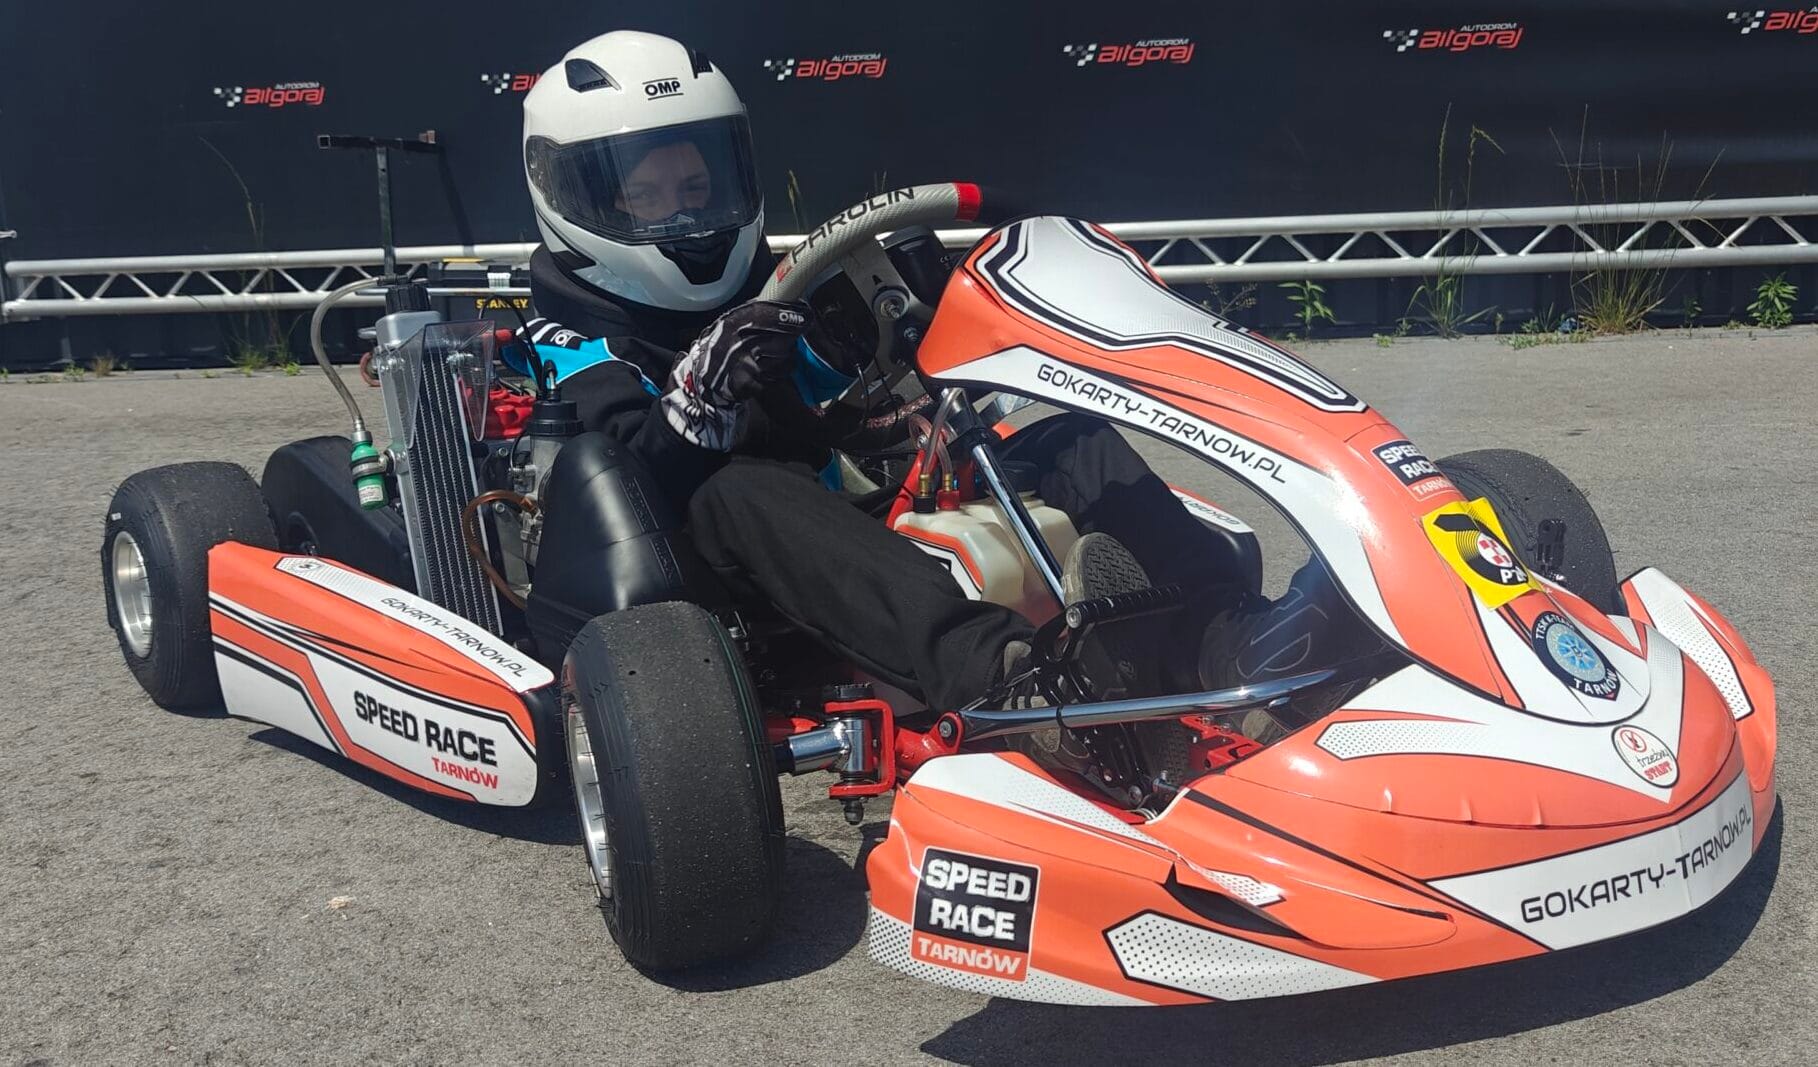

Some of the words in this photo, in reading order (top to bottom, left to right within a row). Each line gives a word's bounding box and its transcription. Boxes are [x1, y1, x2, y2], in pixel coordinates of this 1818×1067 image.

[1460, 22, 1517, 32] AUTODROM
[1135, 38, 1190, 47] AUTODROM
[831, 53, 881, 62] AUTODROM
[644, 80, 681, 96] OMP
[791, 187, 915, 264] PAROLIN
[476, 298, 529, 309] SANEY
[779, 312, 805, 325] OMP
[1037, 363, 1287, 484] GOKARTY-TARNOW.PL
[1380, 444, 1423, 464] SPEE
[1399, 460, 1438, 479] RAC
[381, 597, 528, 678] GOKARTY-TARNOW.PL
[354, 690, 420, 743] SPEED
[424, 718, 498, 767] RACE
[432, 757, 499, 789] TARNÓW
[1644, 760, 1673, 781] START
[1521, 804, 1751, 923] GOKARTY-TARNOW.PL
[926, 859, 1031, 902] SPEED
[929, 898, 1016, 941] RACE
[918, 937, 1021, 975] TARNÓW
